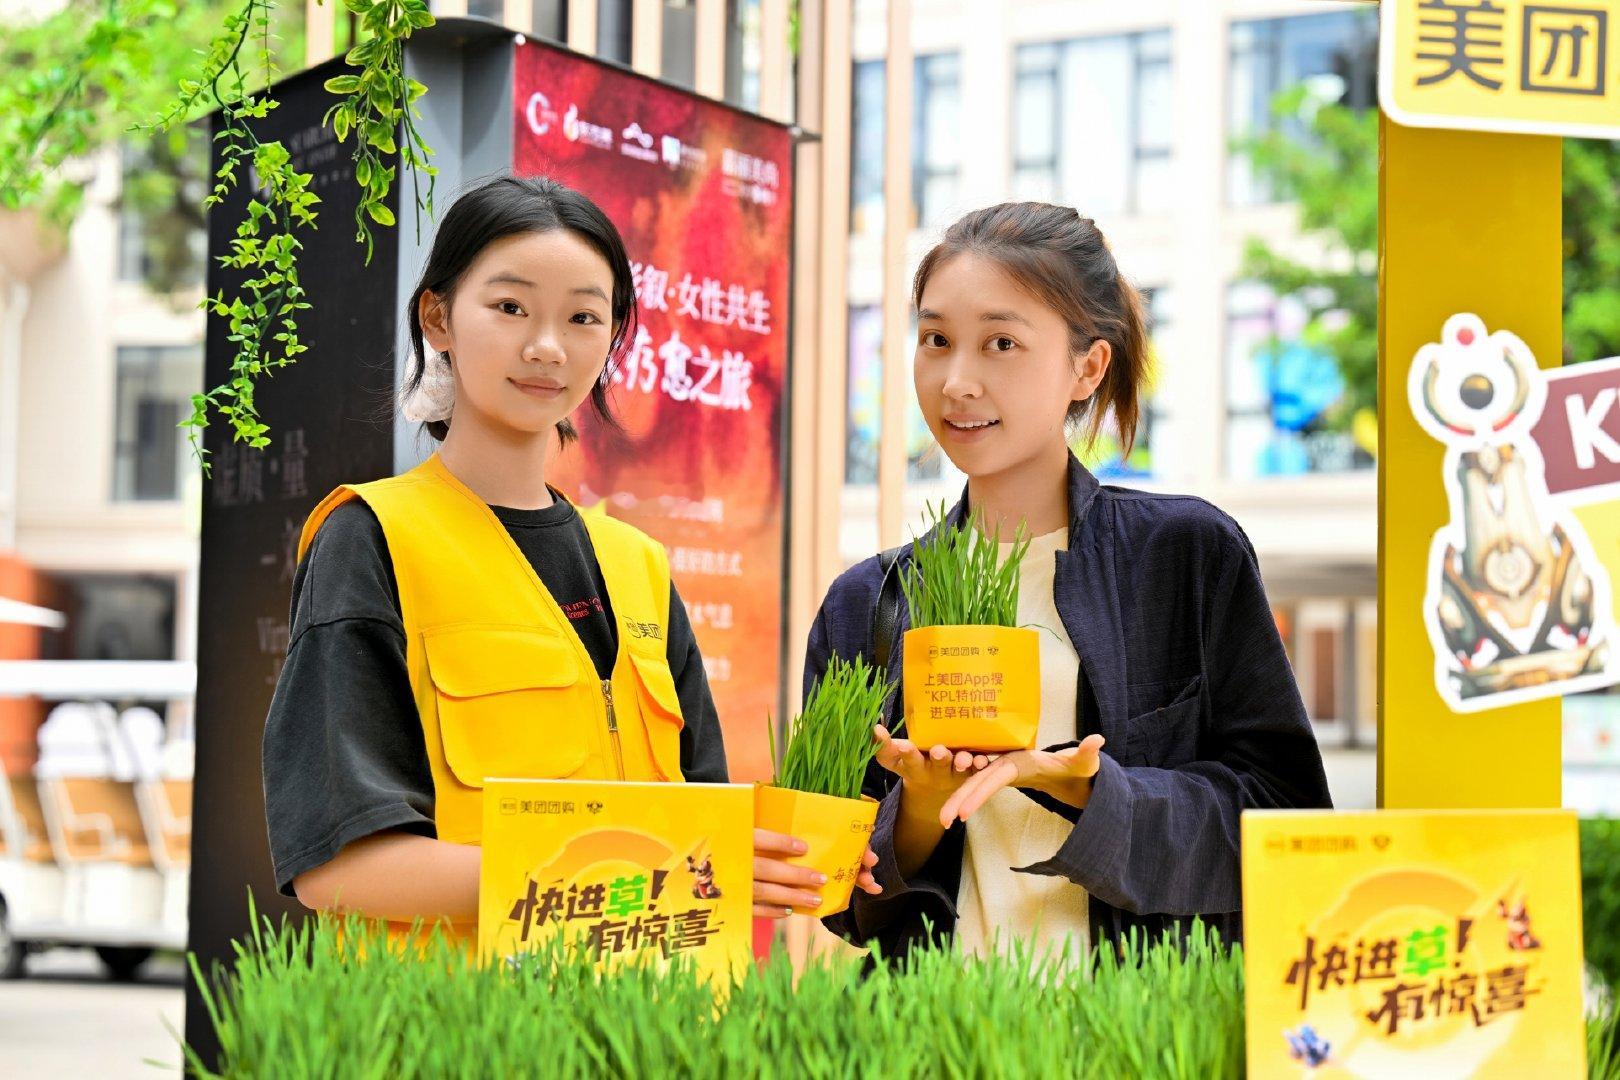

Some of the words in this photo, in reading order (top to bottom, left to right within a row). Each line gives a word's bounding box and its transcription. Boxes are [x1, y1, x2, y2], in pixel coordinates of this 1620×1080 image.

[1416, 0, 1607, 96] 美团
[925, 672, 1003, 687] 上美团App搜
[931, 705, 998, 720] 进草有惊喜
[521, 800, 575, 814] 美团团购
[565, 908, 721, 963] 有惊喜
[1366, 964, 1542, 1036] 有惊喜
